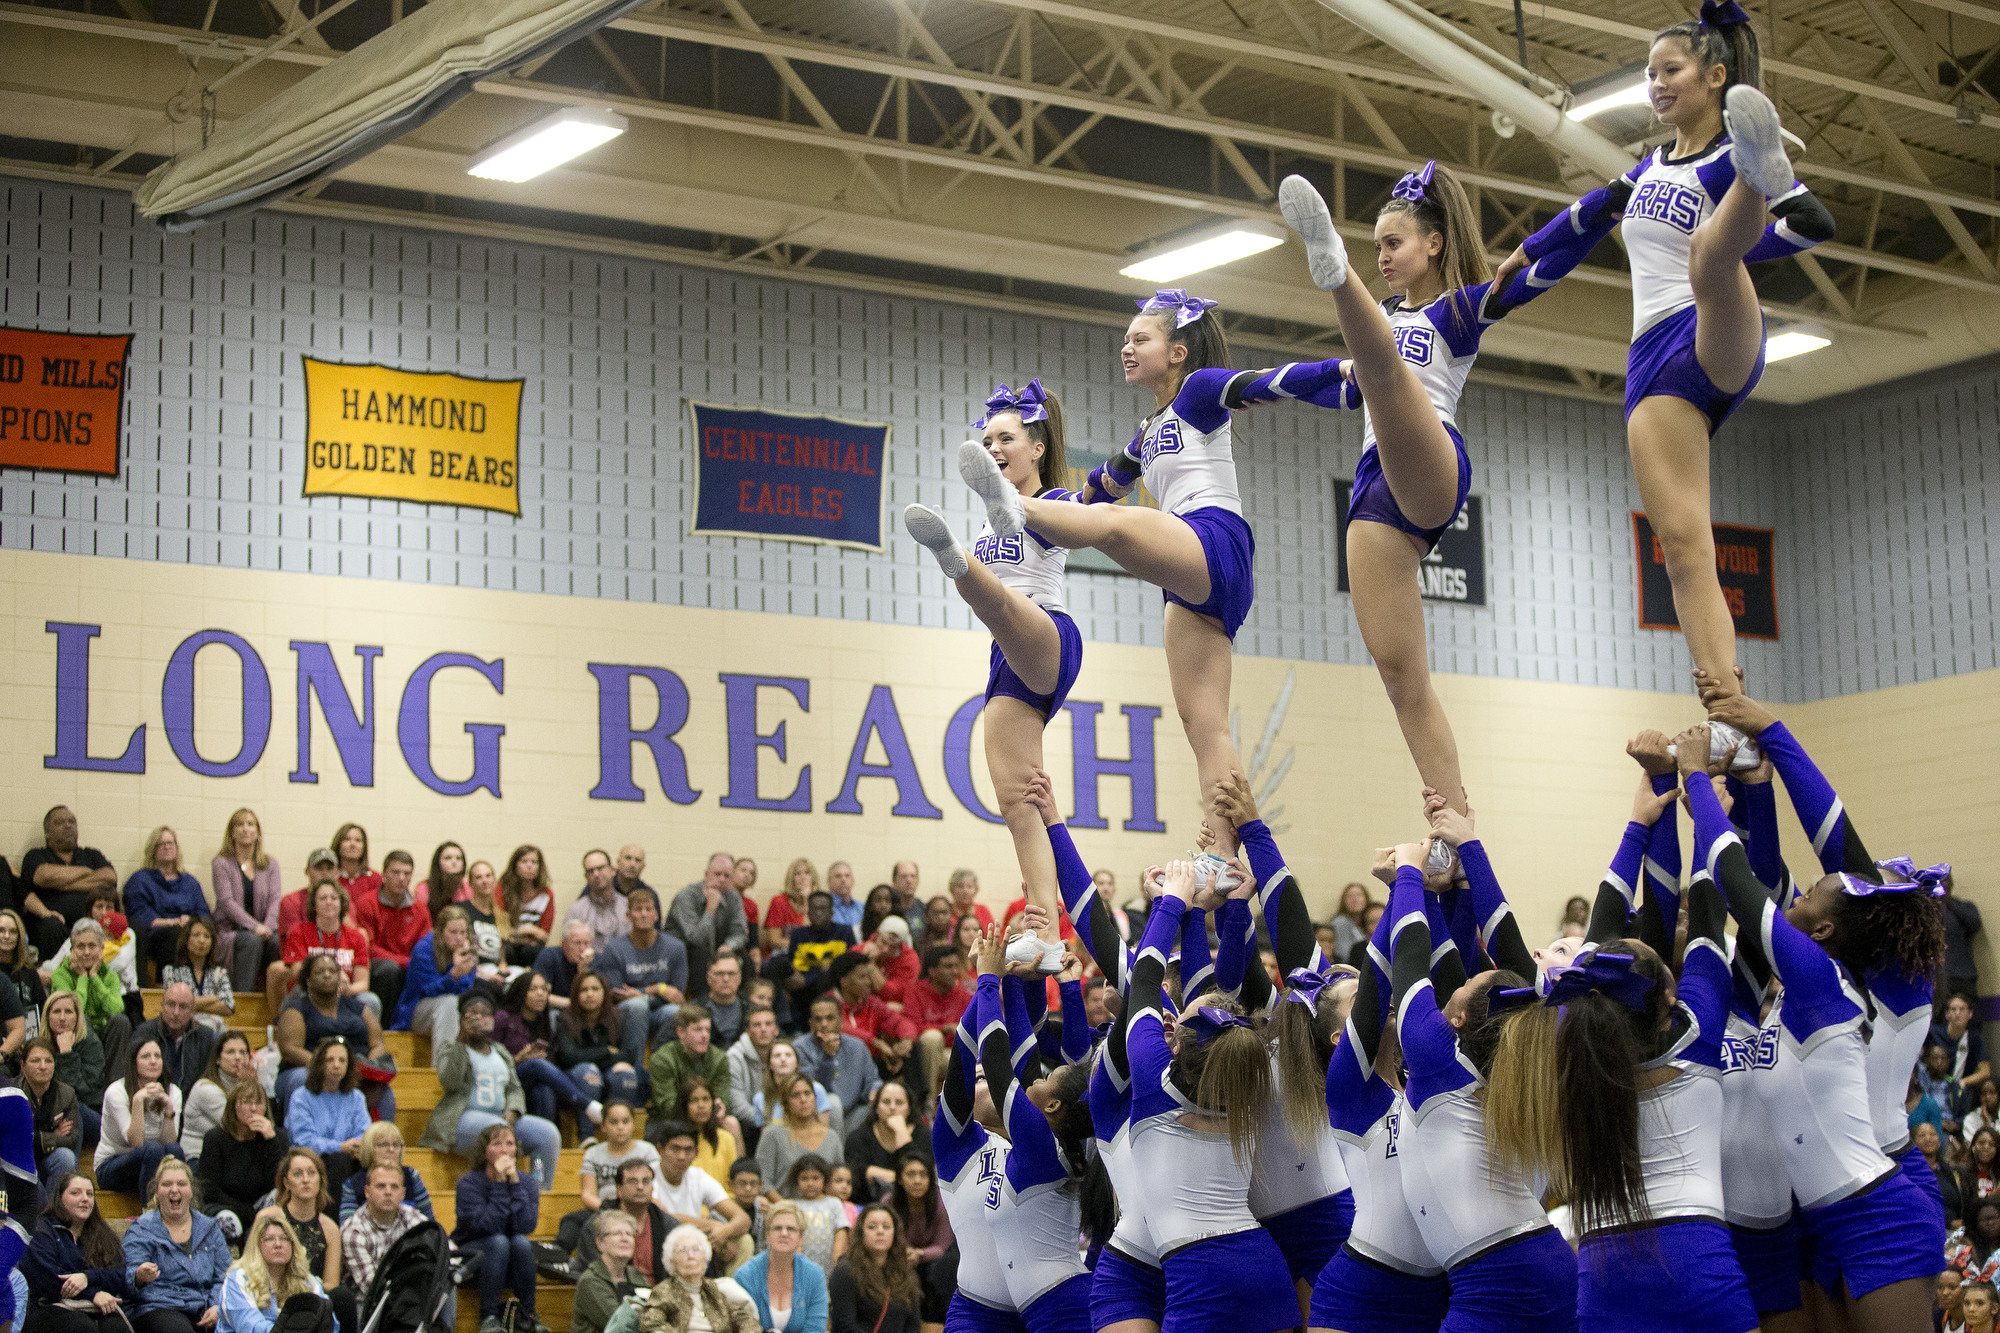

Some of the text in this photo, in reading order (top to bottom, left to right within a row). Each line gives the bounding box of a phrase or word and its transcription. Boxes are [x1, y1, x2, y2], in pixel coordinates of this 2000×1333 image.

[41, 356, 120, 390] MILLS
[0, 406, 93, 445] PIONS
[341, 388, 487, 434] HAMMOND
[312, 441, 514, 488] GOLDEN BEARS
[704, 426, 877, 477] CENTENNIAL
[1141, 419, 1184, 470] RHS
[738, 480, 843, 521] EAGLES
[43, 621, 1166, 833] LONG REACH
